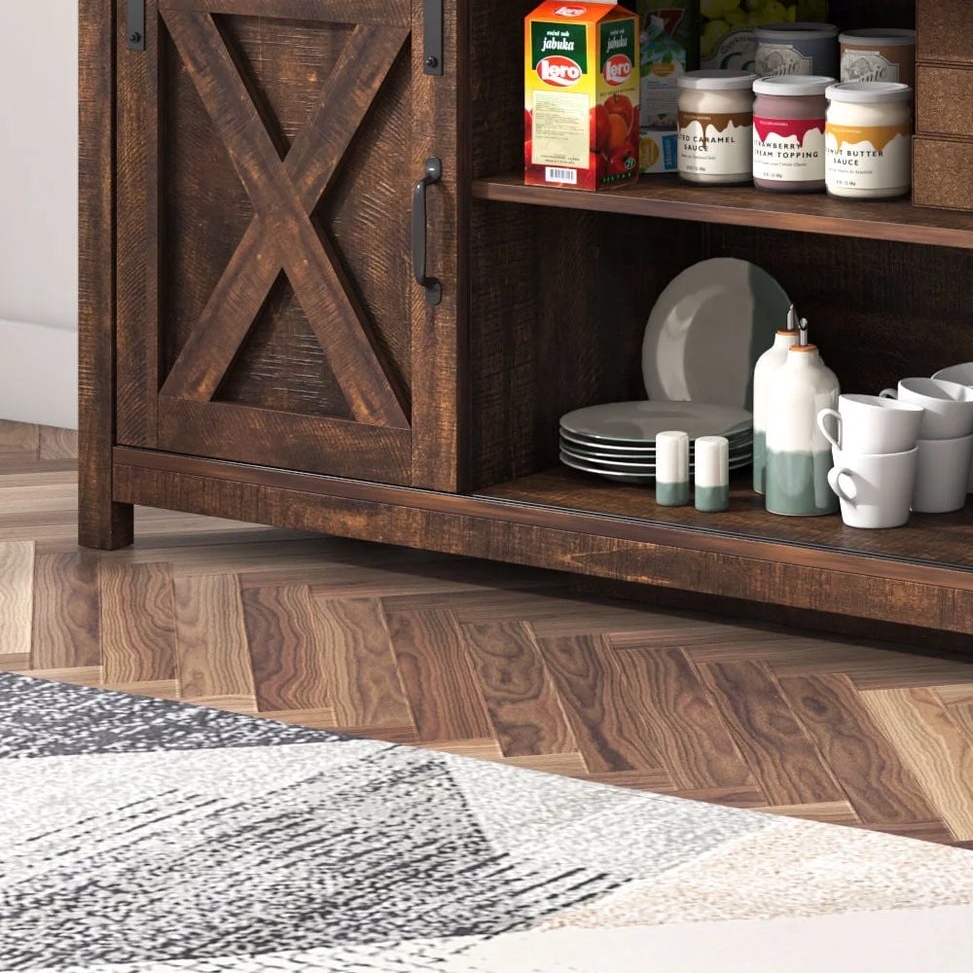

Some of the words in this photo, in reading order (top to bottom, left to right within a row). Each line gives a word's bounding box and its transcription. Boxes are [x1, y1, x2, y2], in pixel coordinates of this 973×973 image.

[541, 37, 574, 51] jabuka
[606, 35, 628, 53] jabuka
[680, 133, 690, 142] TED
[693, 136, 736, 144] CARAMEL
[684, 143, 708, 152] SAUCE
[777, 151, 818, 159] TOPPING
[846, 149, 884, 157] BUTTER
[833, 157, 858, 166] SAUCE
